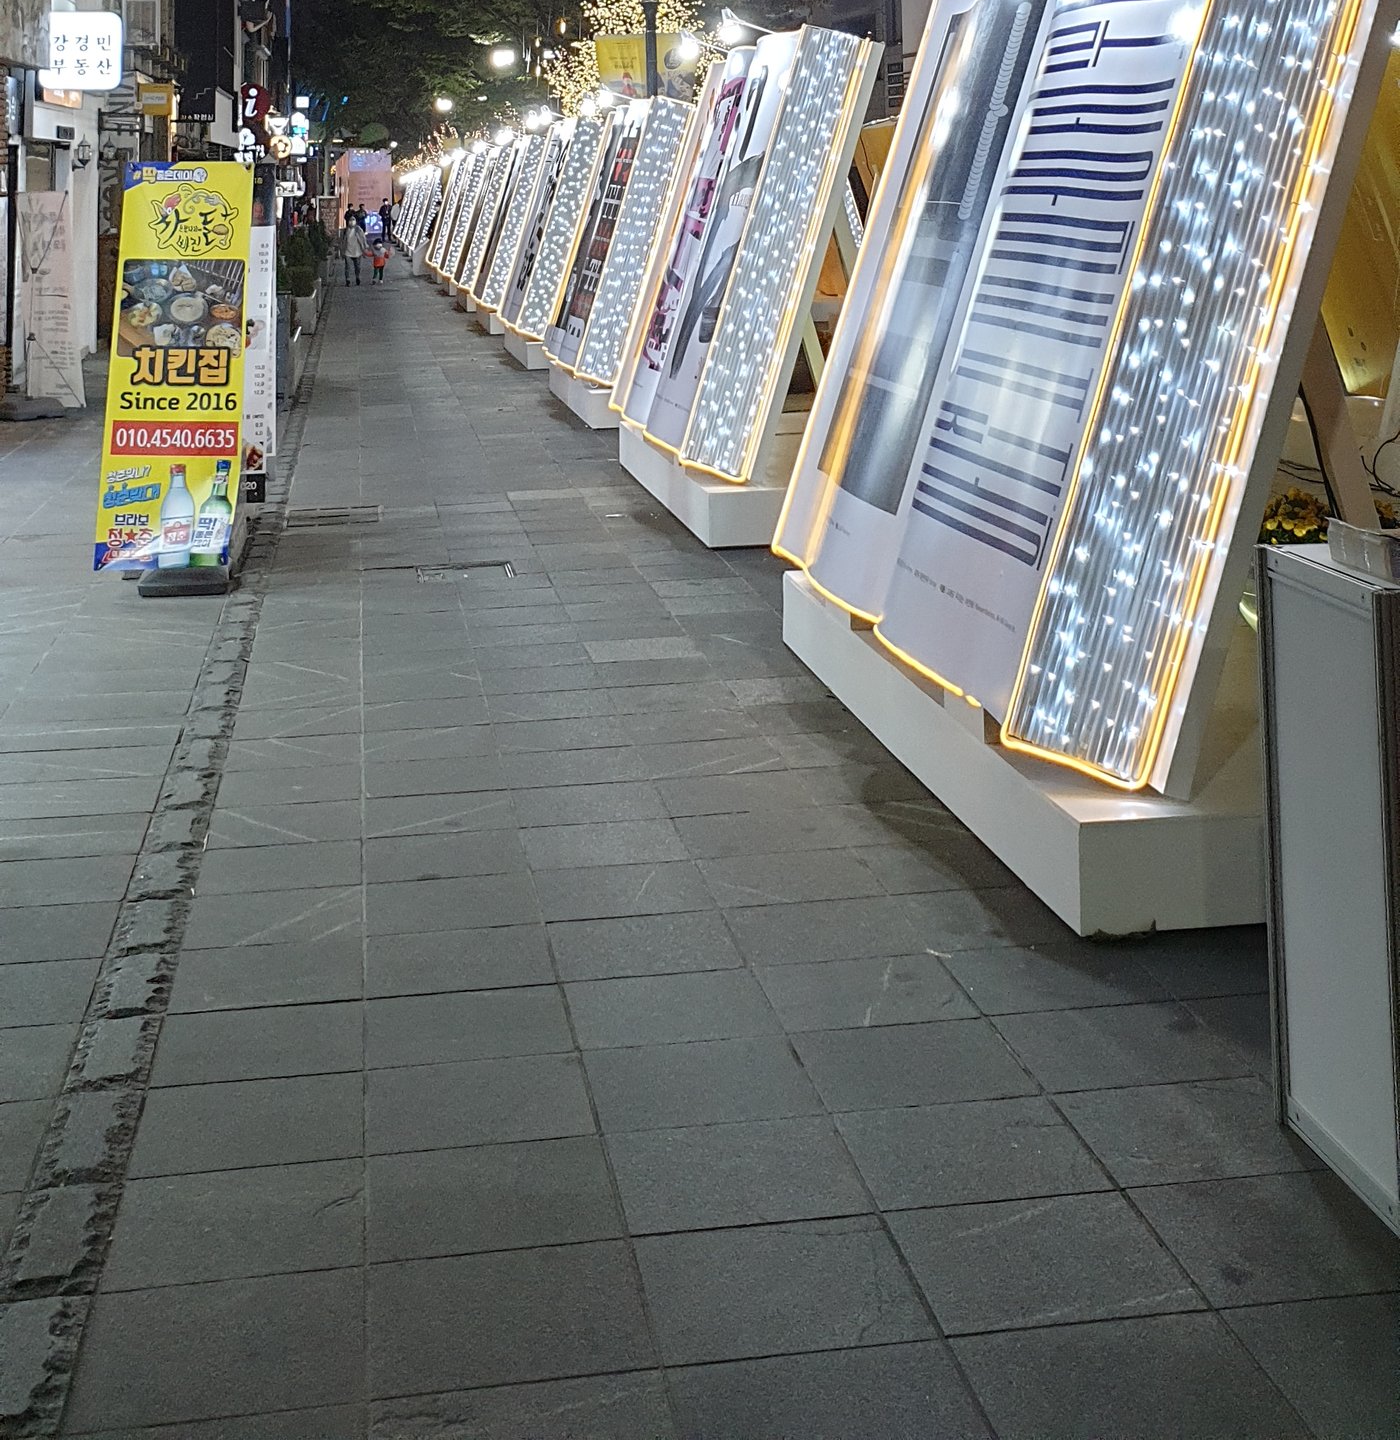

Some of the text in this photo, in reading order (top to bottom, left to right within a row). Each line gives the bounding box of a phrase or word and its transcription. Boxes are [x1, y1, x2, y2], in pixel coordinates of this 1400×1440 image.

[130, 345, 230, 386] 치킨집
[119, 391, 237, 411] Since 2016
[115, 427, 235, 449] 010.4540.6635
[114, 513, 150, 526] 브라보
